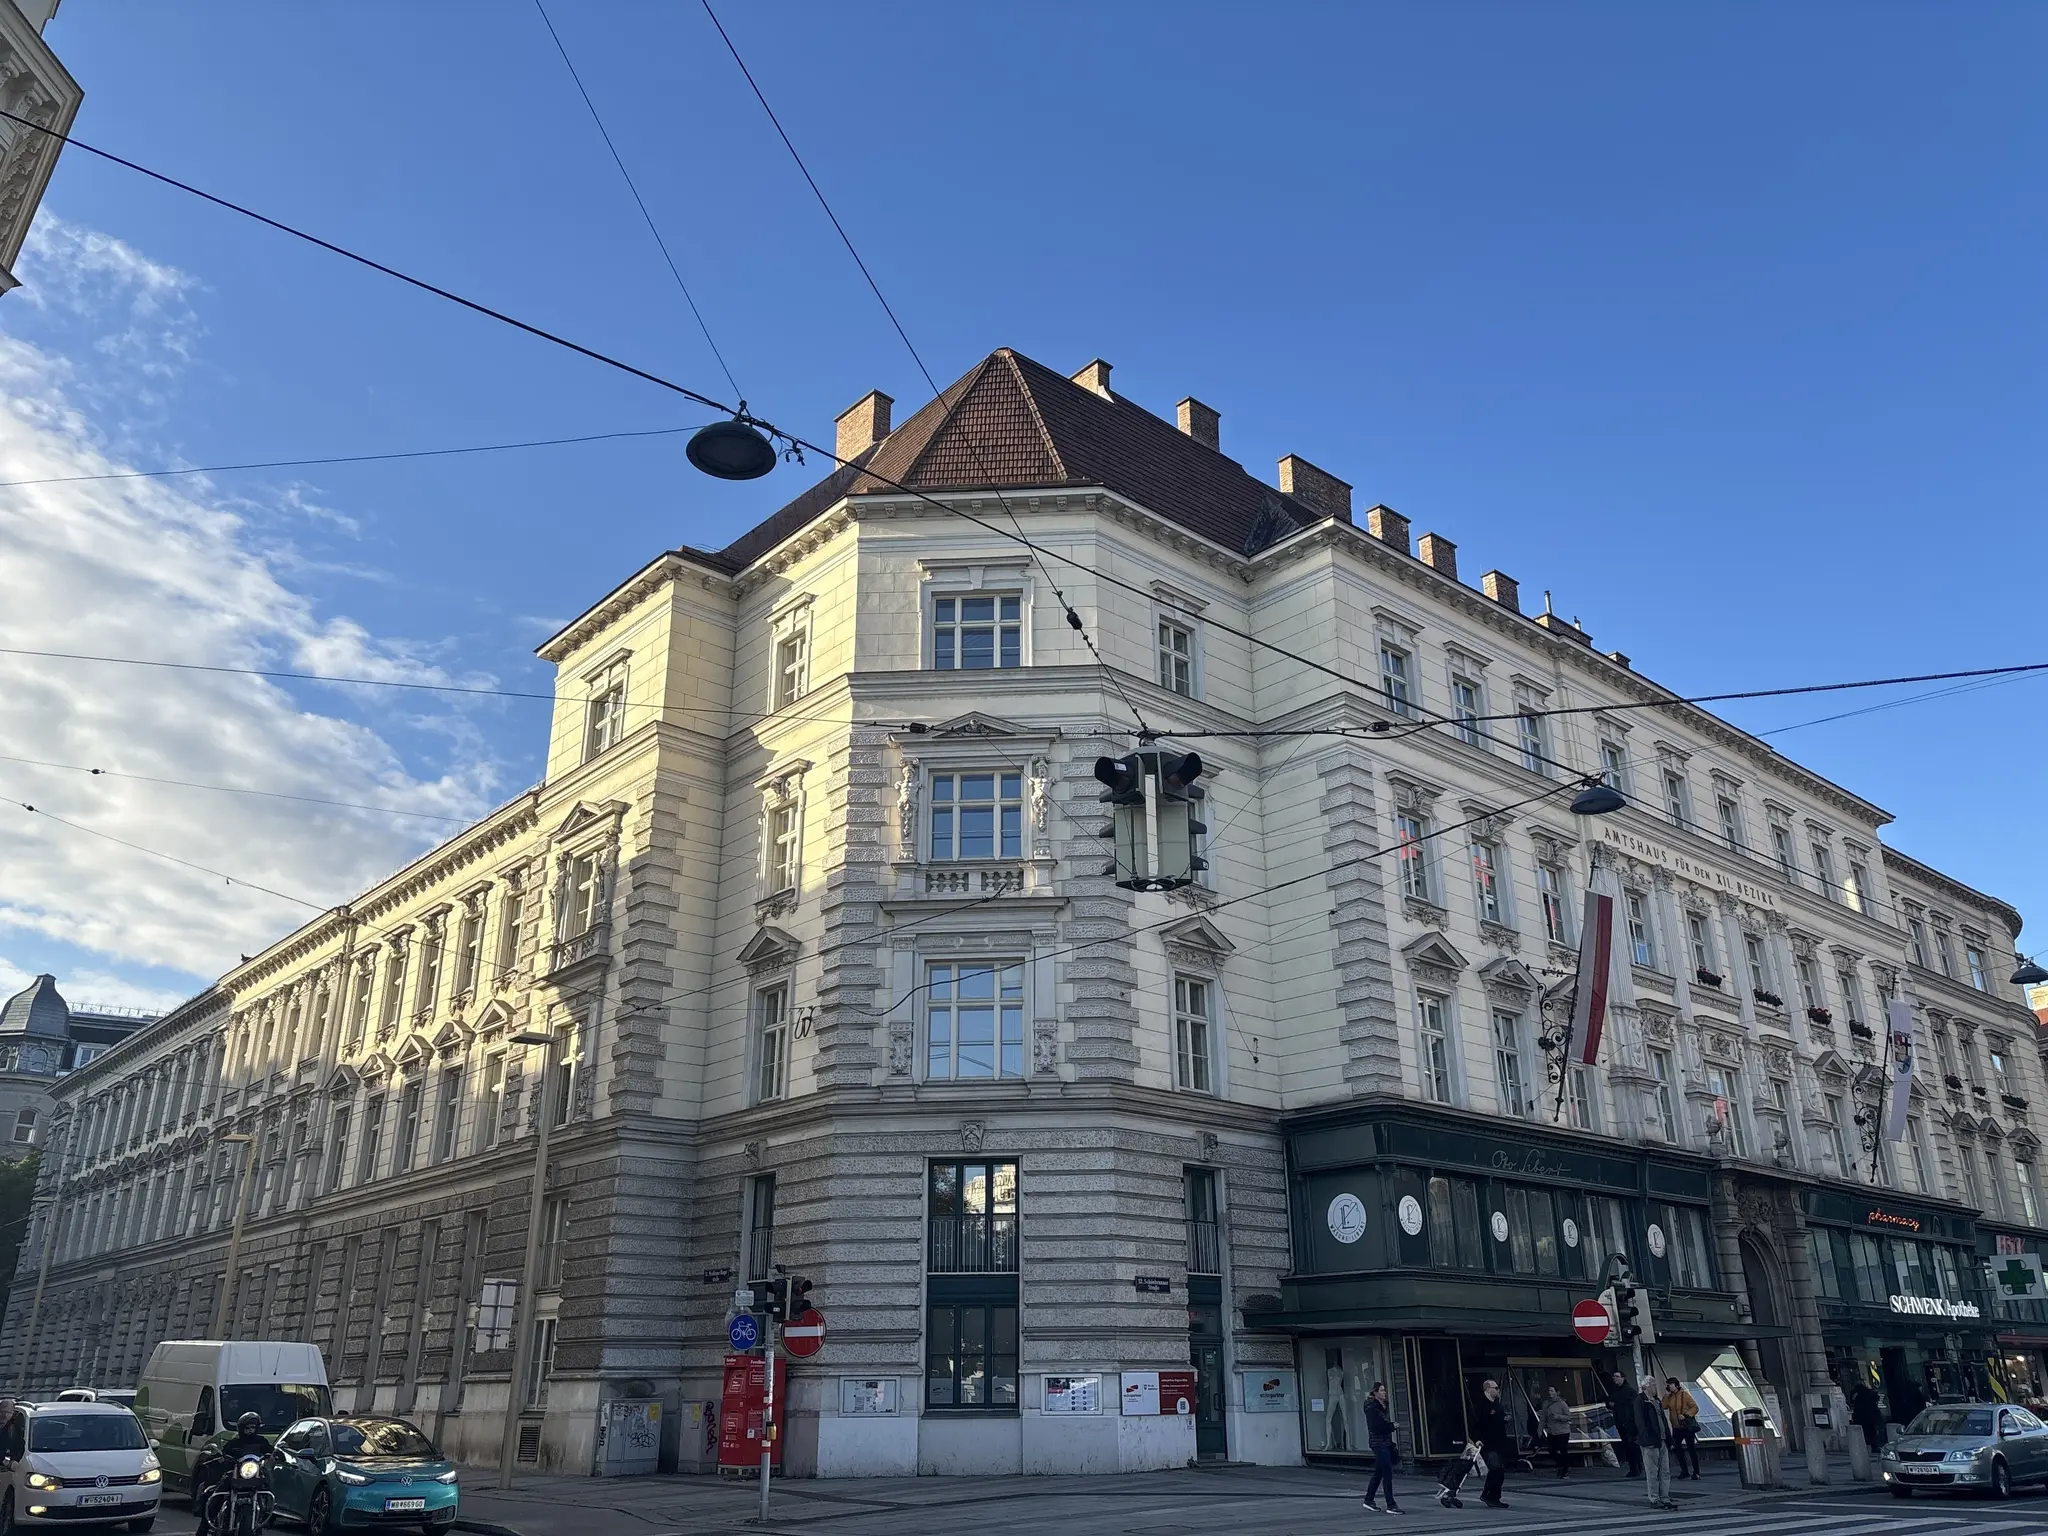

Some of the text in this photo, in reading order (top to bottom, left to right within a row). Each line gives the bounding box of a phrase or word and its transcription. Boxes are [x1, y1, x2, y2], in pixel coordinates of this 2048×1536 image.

[1603, 826, 1668, 863] AMTSHAUS
[1675, 857, 1691, 872] FÜR
[1694, 866, 1711, 881] DEN
[1737, 883, 1774, 906] BEZIRK
[1868, 1207, 1920, 1232] pharmacy
[1889, 1295, 1981, 1321] SCHWENK Apotheke
